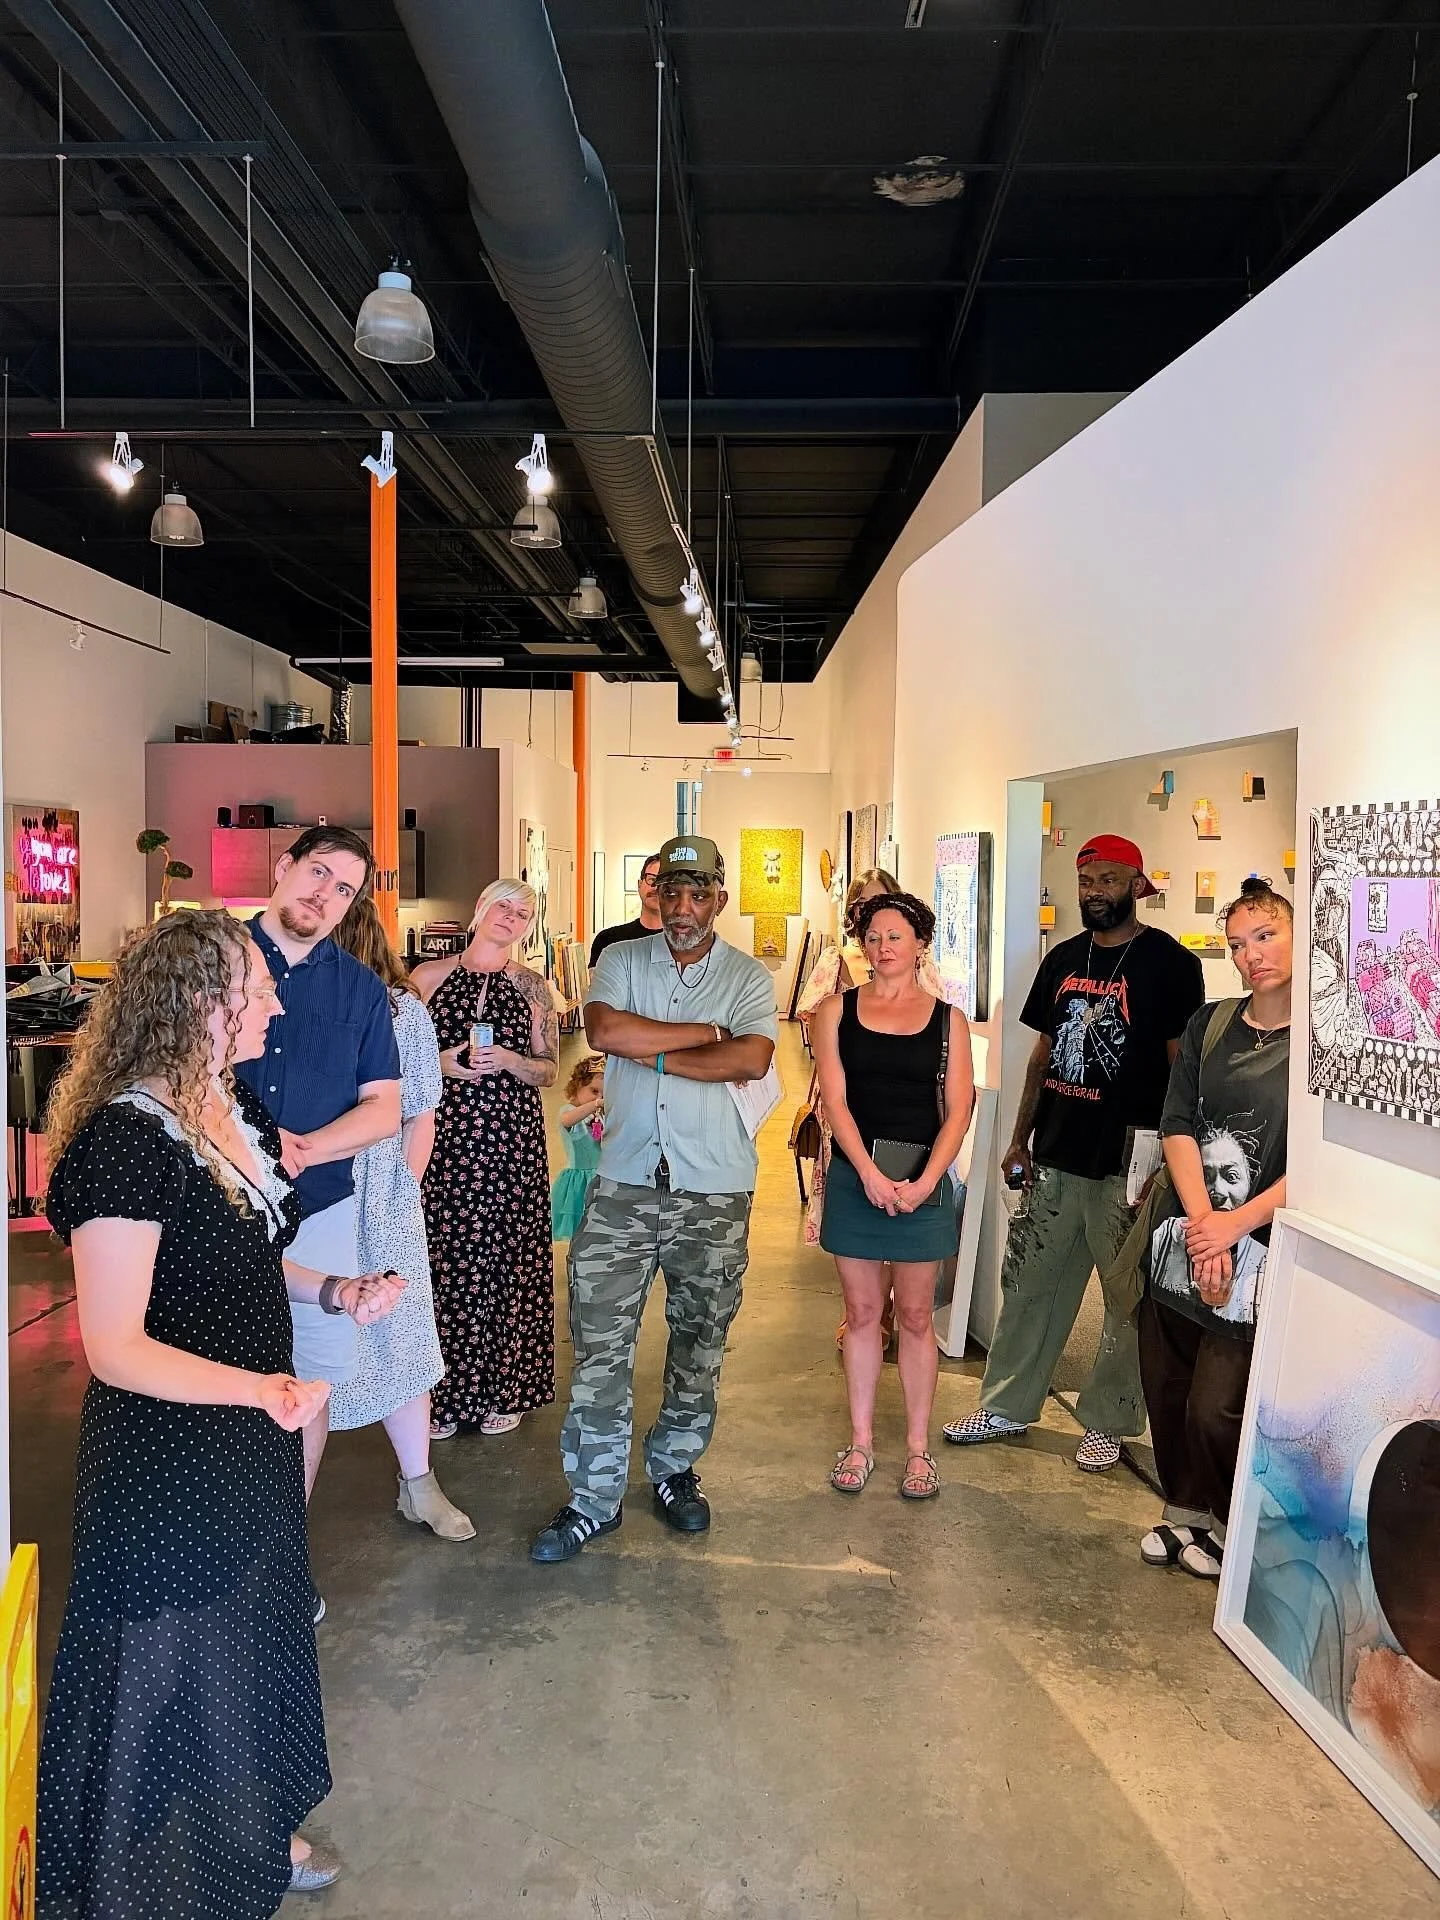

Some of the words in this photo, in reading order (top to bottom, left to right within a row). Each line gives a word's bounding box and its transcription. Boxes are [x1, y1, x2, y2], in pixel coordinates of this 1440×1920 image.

[57, 846, 78, 865] are
[39, 863, 70, 894] loved
[426, 938, 452, 951] ART
[1055, 970, 1131, 1026] METALLICA
[1086, 1088, 1101, 1100] ALL
